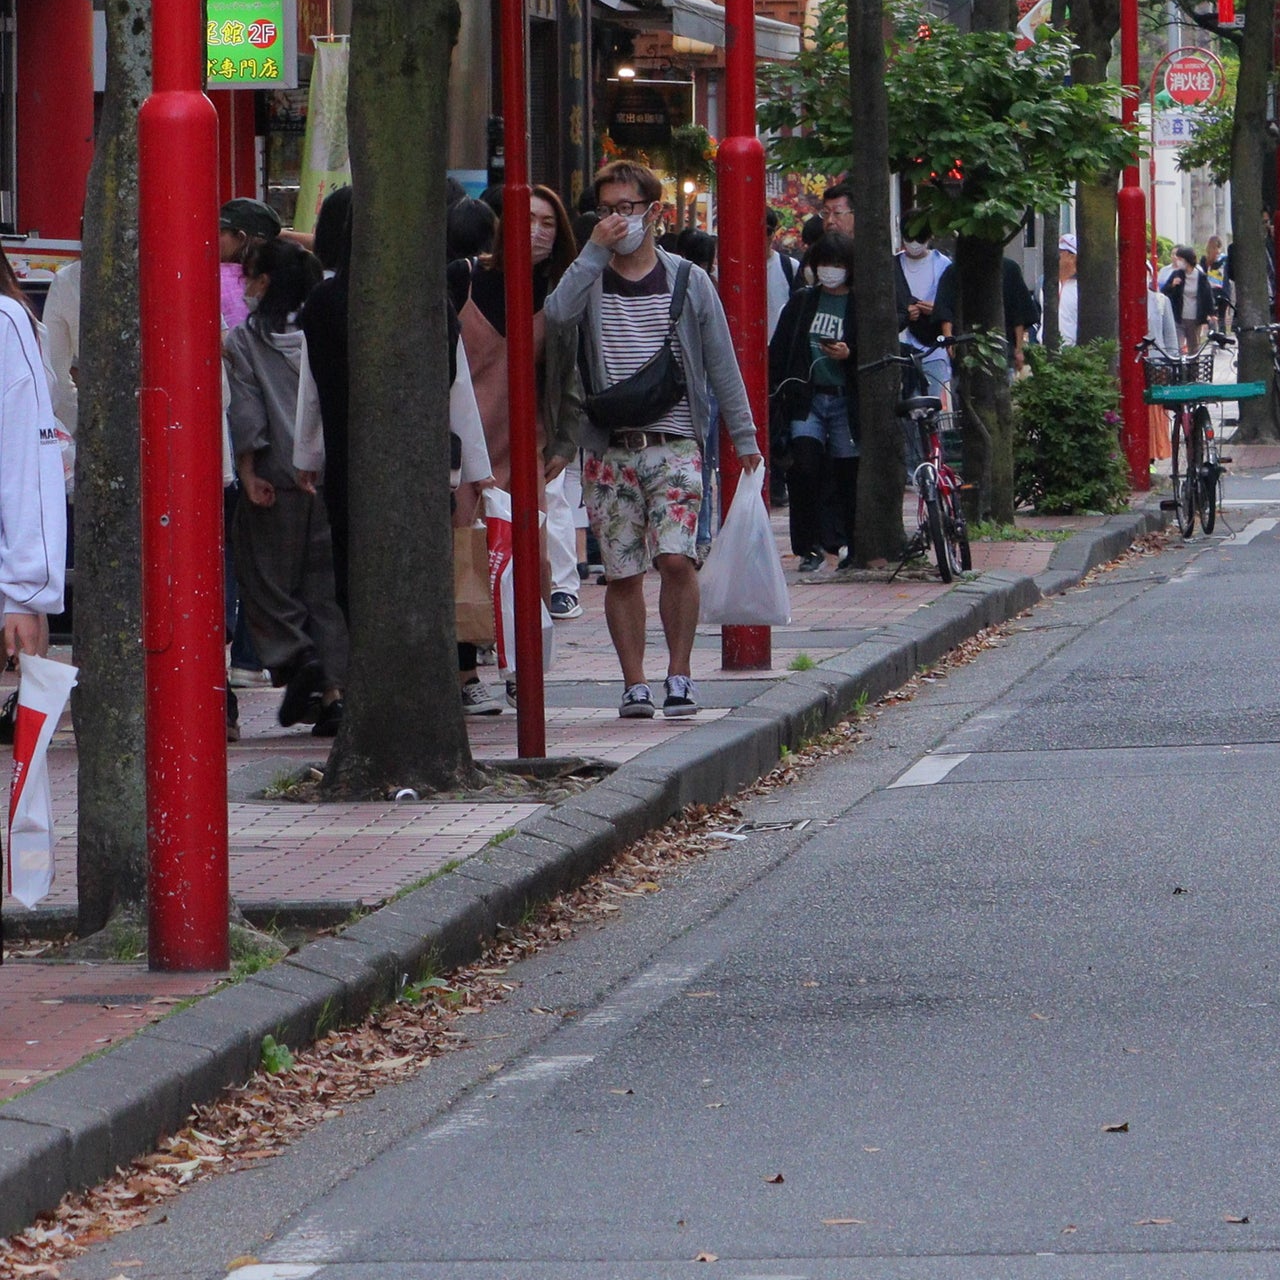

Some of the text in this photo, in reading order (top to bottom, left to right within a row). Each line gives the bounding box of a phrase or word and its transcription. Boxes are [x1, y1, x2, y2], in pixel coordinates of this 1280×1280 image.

[248, 22, 276, 44] 2F
[1170, 71, 1211, 92] 消火栓
